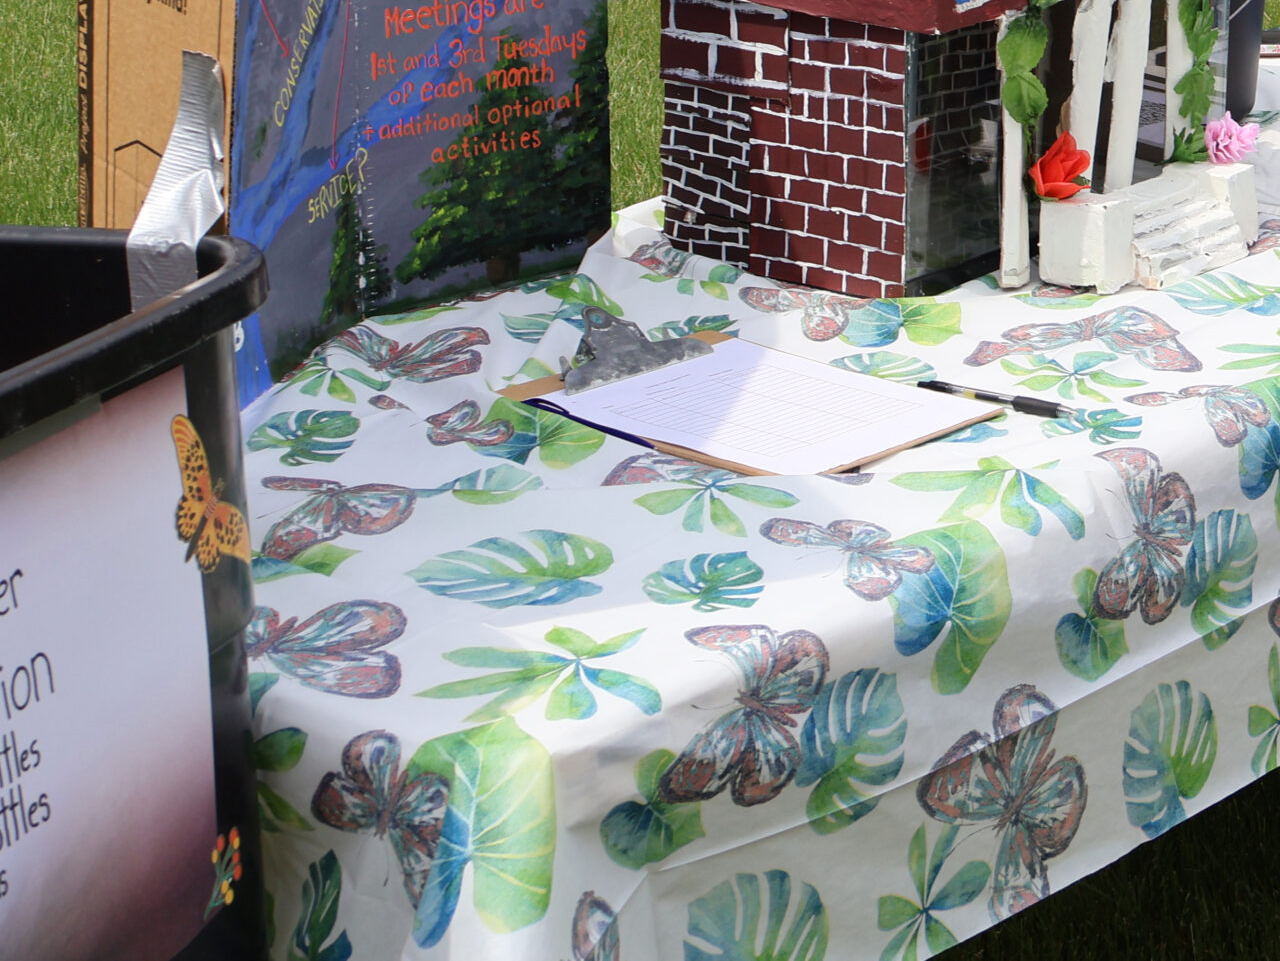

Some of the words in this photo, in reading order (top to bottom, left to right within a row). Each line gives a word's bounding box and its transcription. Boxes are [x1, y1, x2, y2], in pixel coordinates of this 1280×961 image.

[371, 51, 398, 82] 1st
[403, 42, 441, 72] and
[448, 36, 487, 69] 3rd
[490, 24, 588, 62] Tuesdays
[388, 82, 415, 106] of
[420, 72, 475, 101] each
[486, 58, 556, 91] month
[379, 105, 481, 140] additional
[487, 84, 583, 125] optional
[431, 129, 542, 164] activities
[308, 147, 368, 224] SERVICE?
